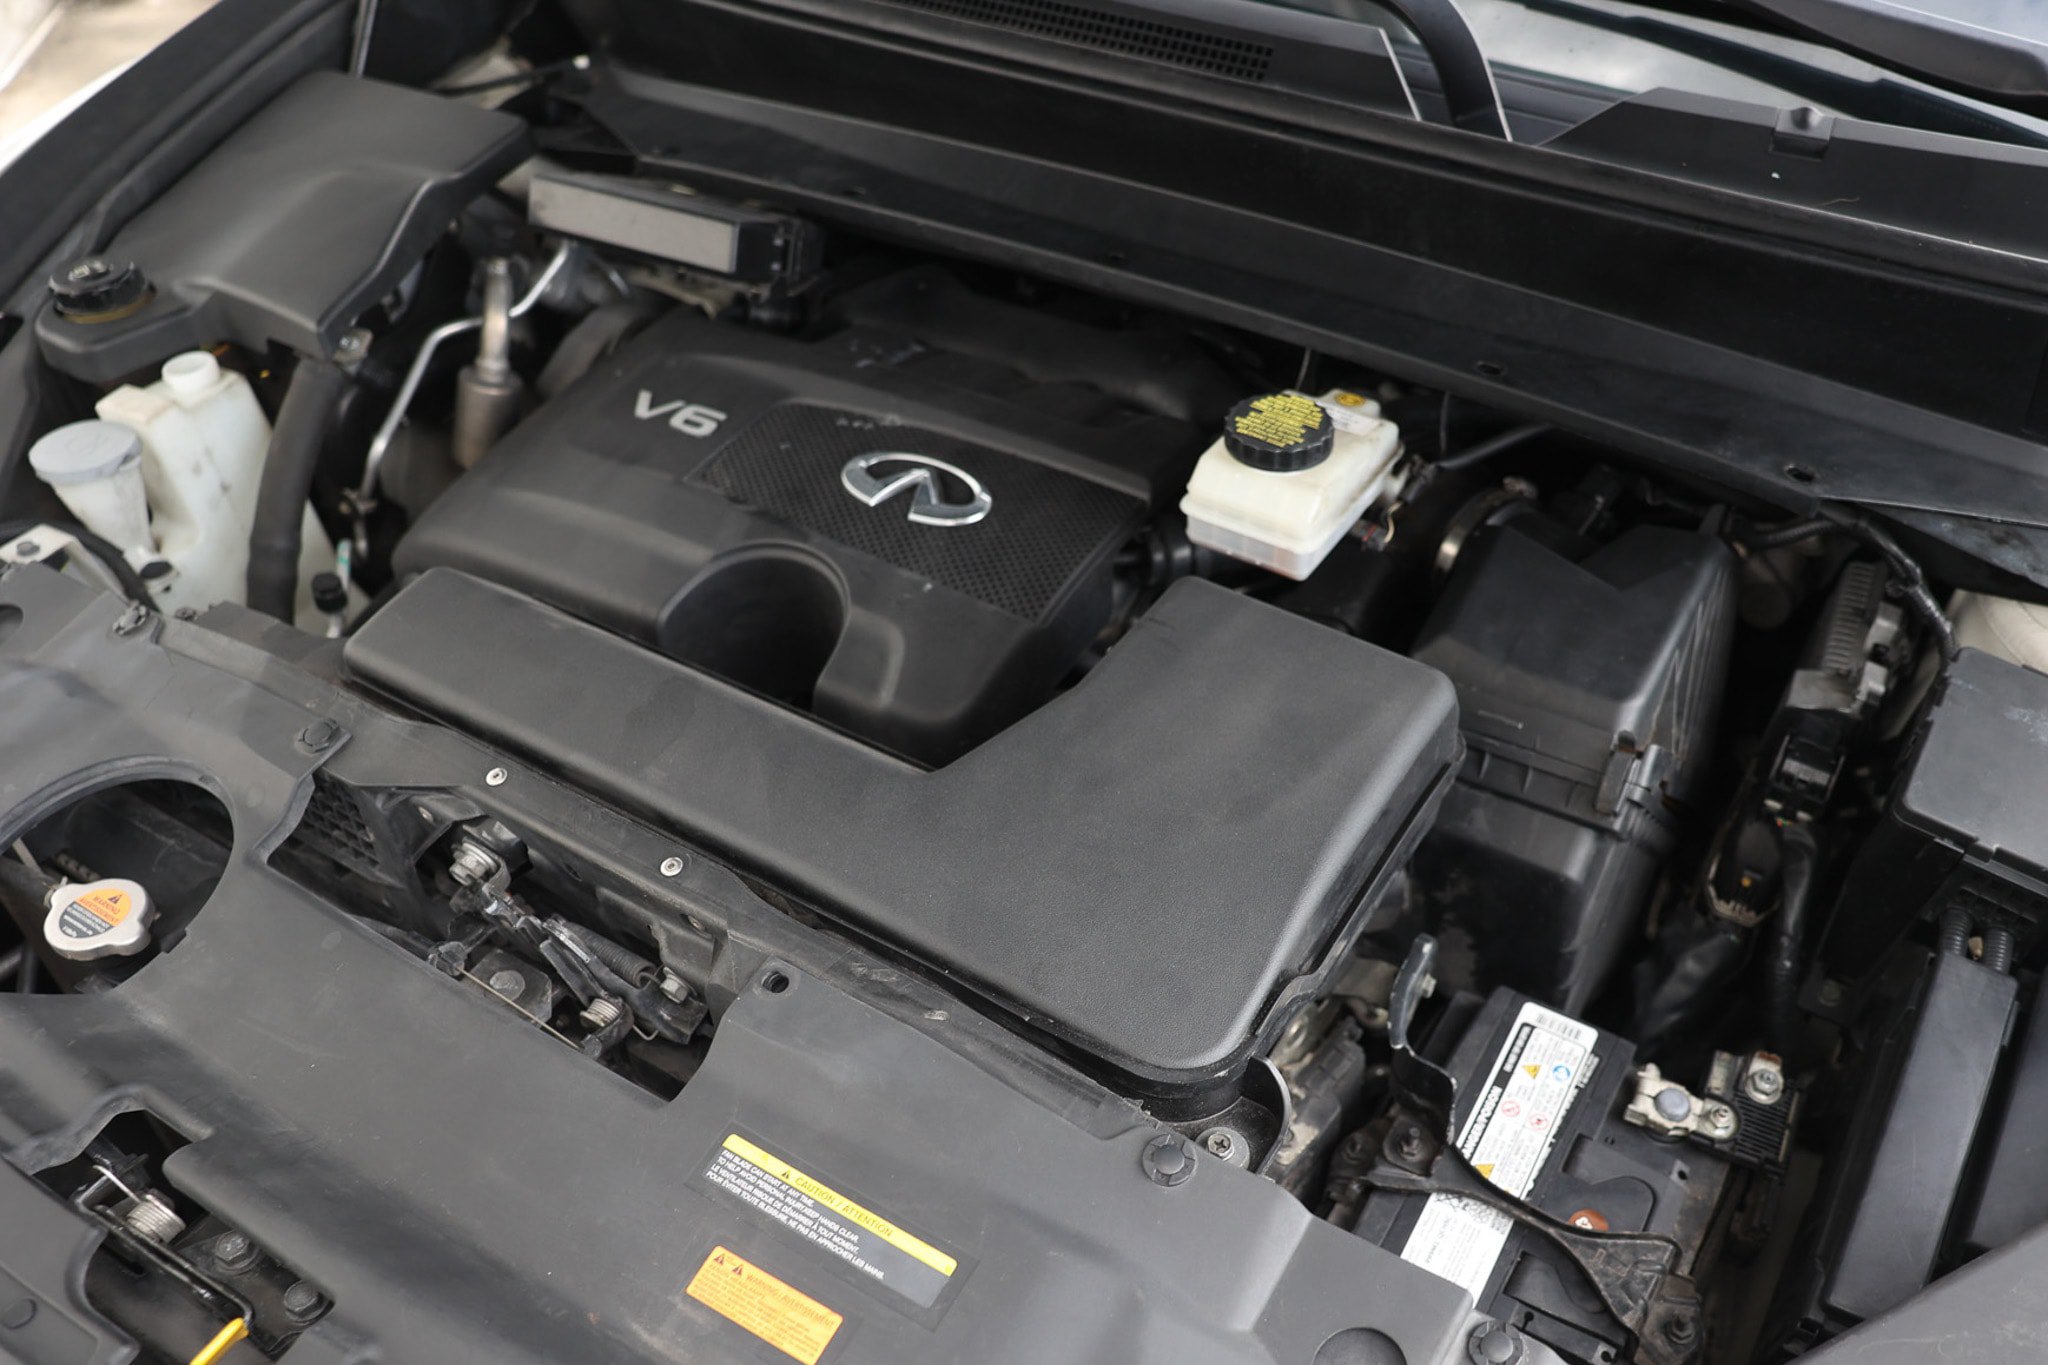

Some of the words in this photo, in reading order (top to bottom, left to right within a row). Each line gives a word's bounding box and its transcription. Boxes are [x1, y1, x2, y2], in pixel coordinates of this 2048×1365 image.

[633, 389, 729, 438] V6
[1462, 1084, 1503, 1160] ANGER/POISON
[706, 1171, 723, 1183] POUR
[725, 1161, 741, 1172] HELP
[751, 1166, 764, 1176] CAN
[795, 1177, 835, 1203] CAUTION
[843, 1204, 892, 1235] ATTENTION
